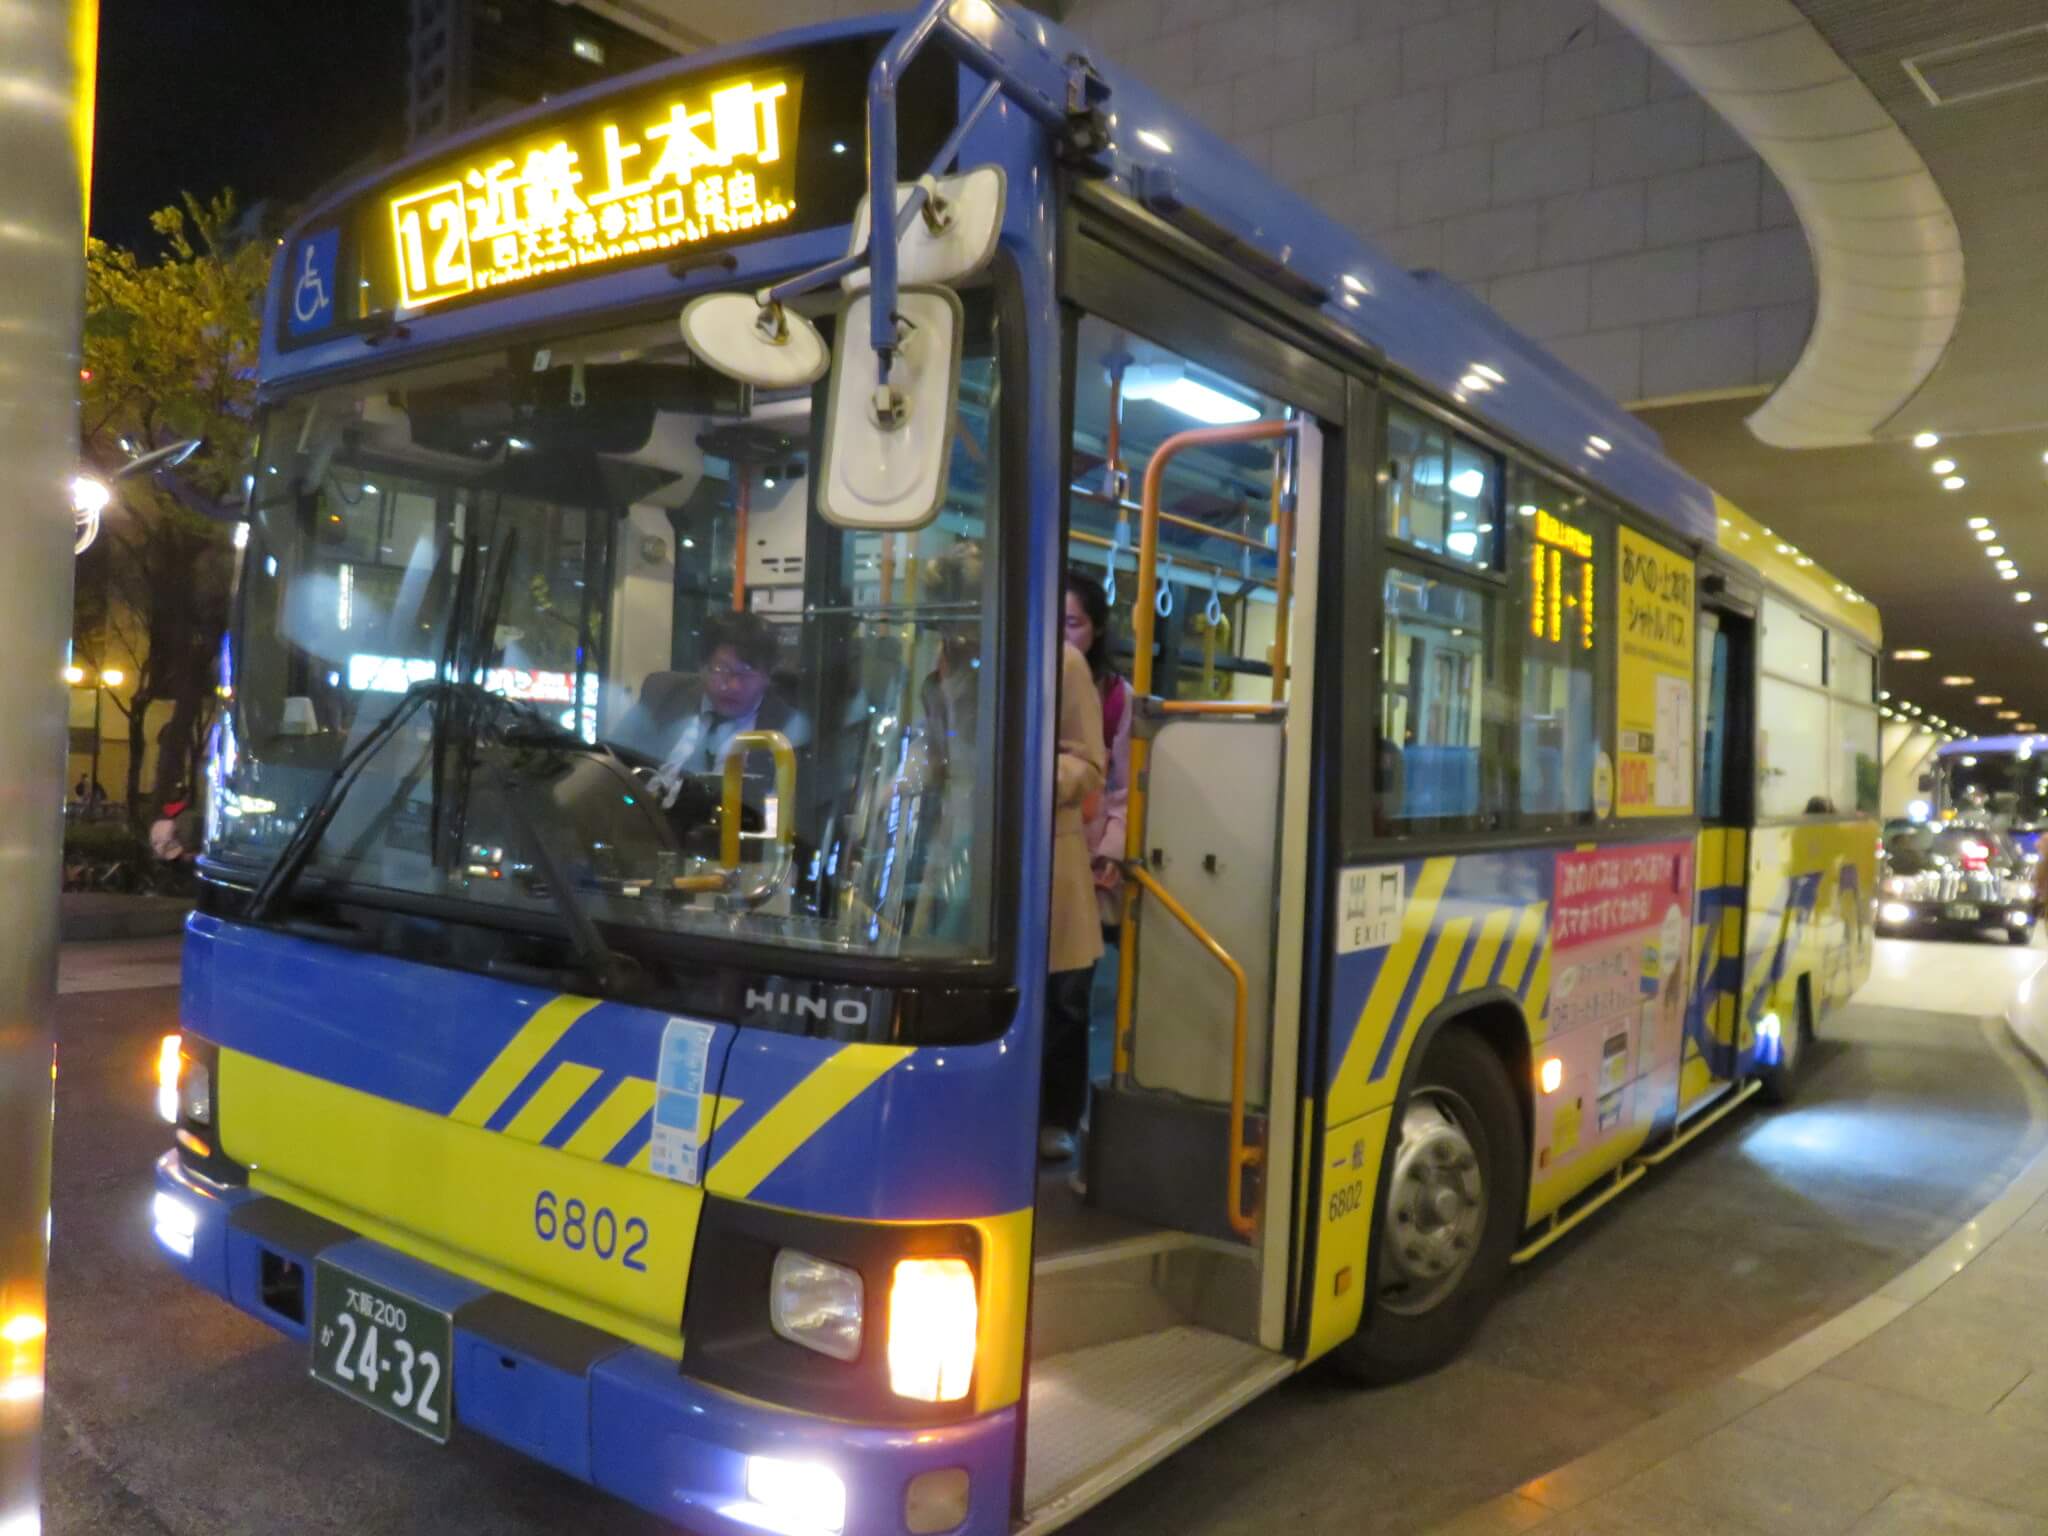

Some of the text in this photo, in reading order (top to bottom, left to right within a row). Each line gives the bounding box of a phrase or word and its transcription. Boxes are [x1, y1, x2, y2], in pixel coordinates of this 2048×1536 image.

[465, 81, 788, 242] 近鉄上本町
[401, 199, 468, 293] 12
[1353, 921, 1387, 946] EXIT
[745, 989, 868, 1025] HINO
[534, 1190, 649, 1273] 6802
[1328, 1180, 1364, 1223] 6802
[335, 1312, 441, 1425] 24-32
